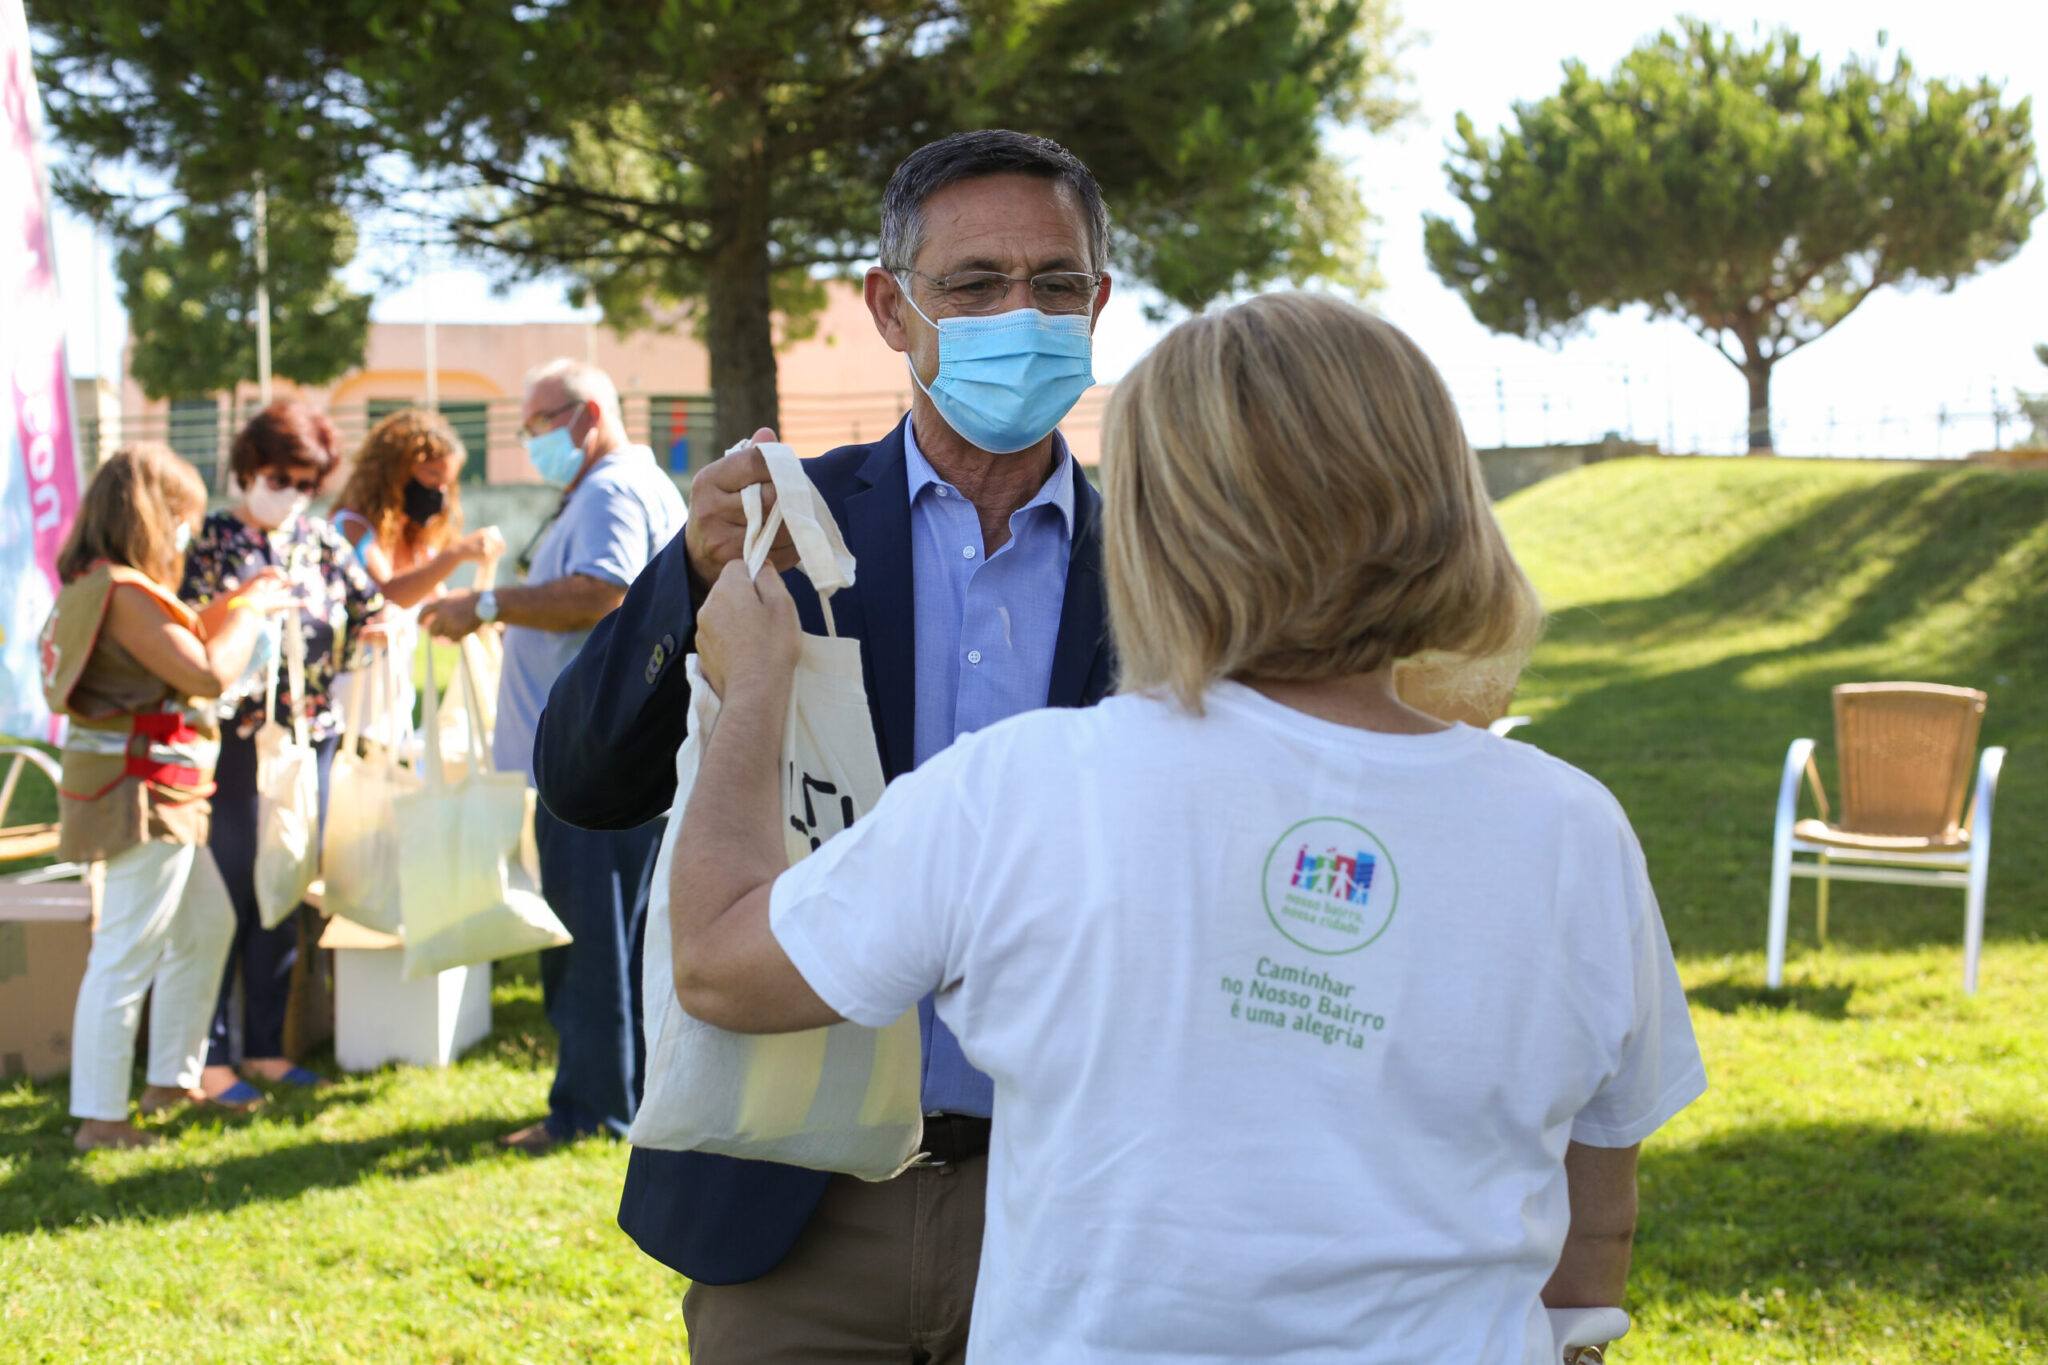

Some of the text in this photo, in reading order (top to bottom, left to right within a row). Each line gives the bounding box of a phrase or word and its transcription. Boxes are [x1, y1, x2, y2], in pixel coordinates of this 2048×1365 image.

[1319, 916, 1360, 935] cidade
[1256, 956, 1356, 998] Caminhar
[1221, 976, 1385, 1031] no Nosso Bairro
[1230, 998, 1364, 1049] é uma alegria
